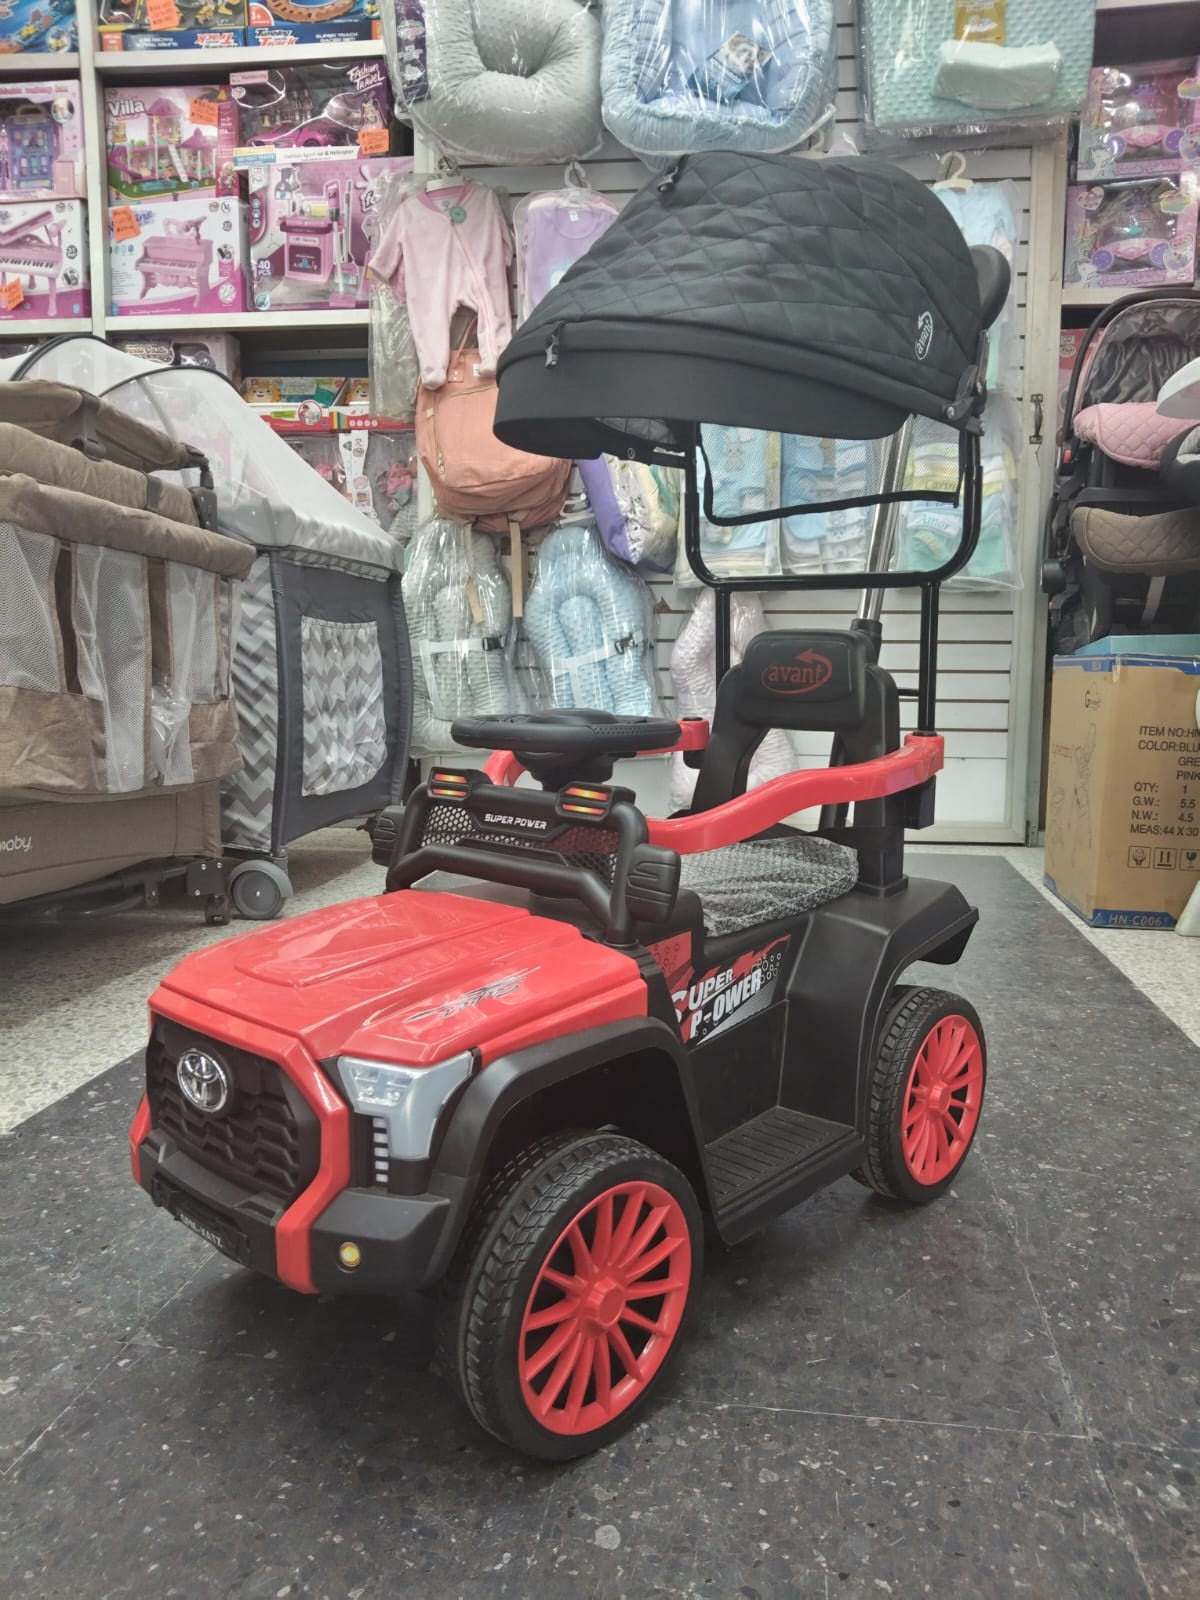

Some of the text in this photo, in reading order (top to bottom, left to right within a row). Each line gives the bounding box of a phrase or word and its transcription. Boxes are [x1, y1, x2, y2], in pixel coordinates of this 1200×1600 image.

[108, 99, 145, 117] Villa
[257, 260, 271, 270] 40
[1139, 725, 1165, 737] ITEM
[1178, 756, 1200, 767] GRE
[1176, 770, 1200, 781] PINK
[1134, 781, 1187, 794] QTY: 1
[1132, 795, 1196, 809] G.W.: 5.5
[484, 813, 547, 830] SUPER POWER
[1131, 809, 1194, 823] N.W.: 4.5
[1130, 823, 1199, 837] MEAS:44 X 30
[1108, 913, 1162, 927] HN-C006
[690, 968, 762, 1039] P-OWER
